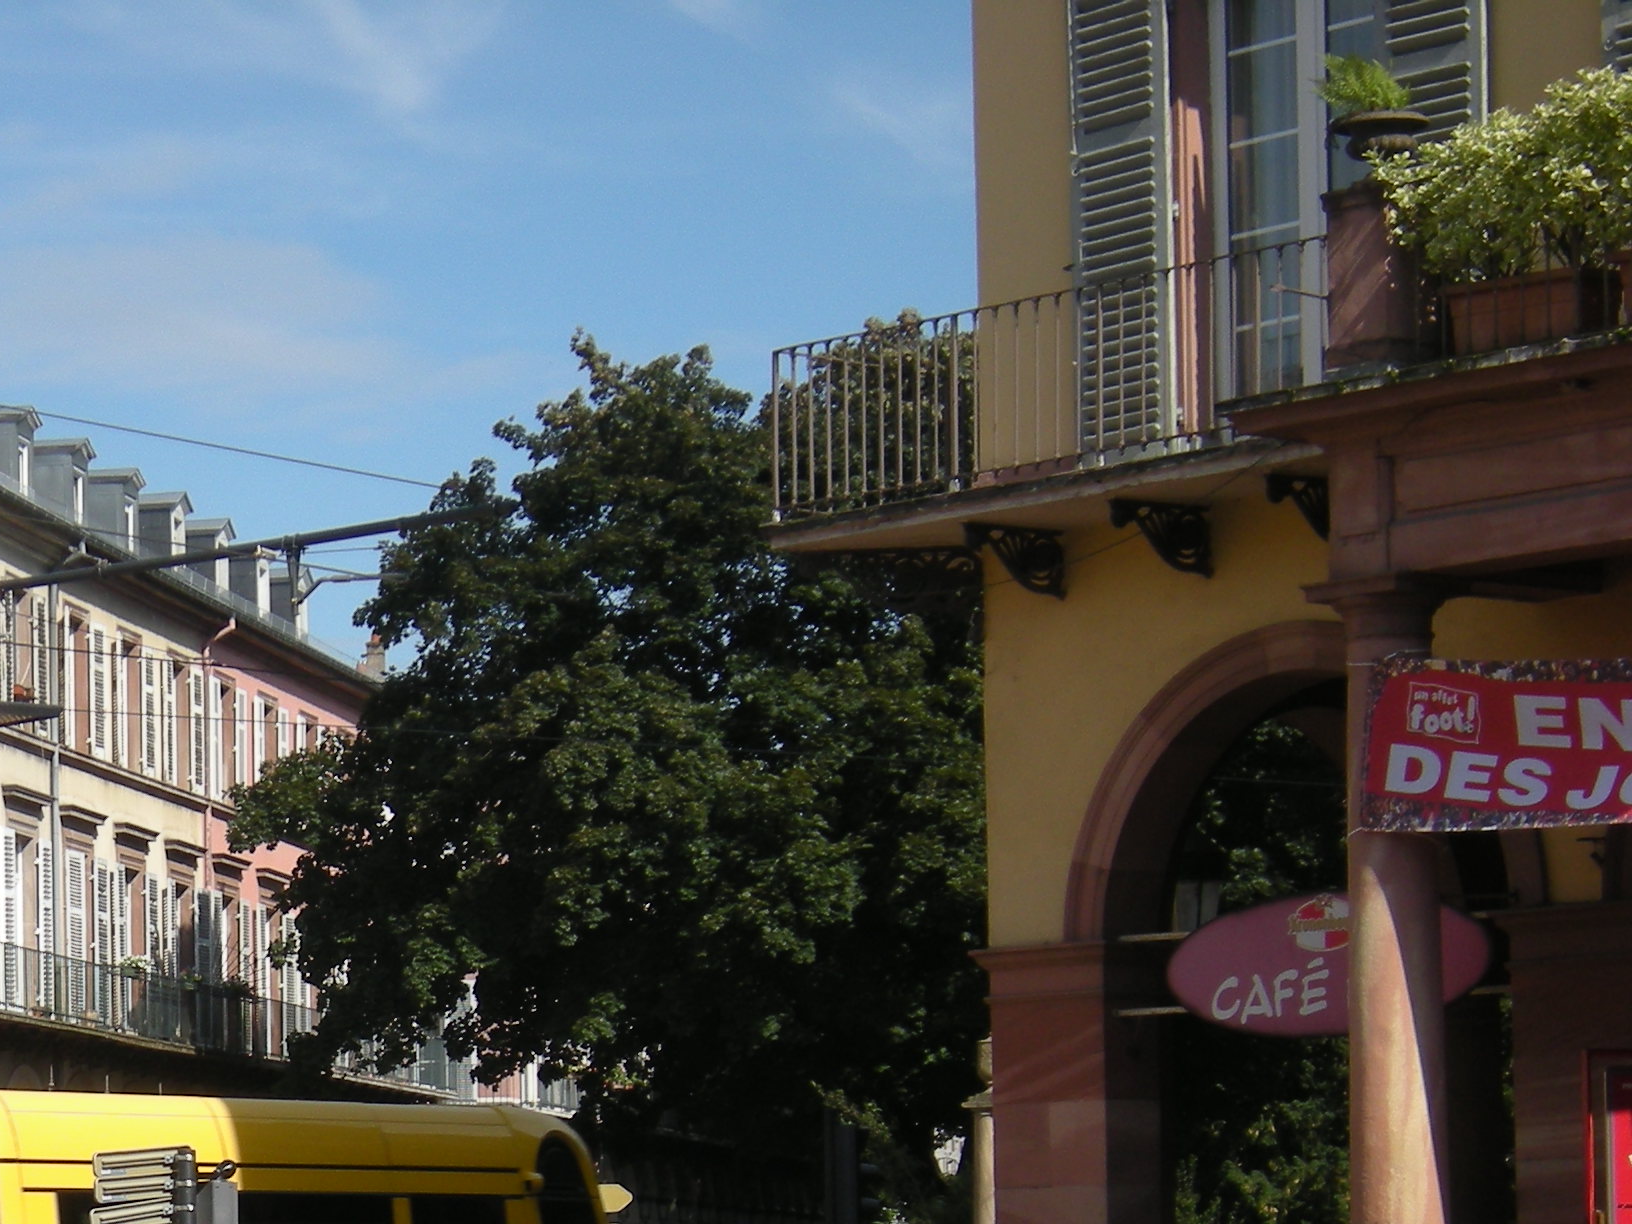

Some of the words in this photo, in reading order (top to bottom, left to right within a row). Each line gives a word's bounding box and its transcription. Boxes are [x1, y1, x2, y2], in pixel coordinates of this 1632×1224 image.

[1384, 743, 1552, 807] DES
[1565, 765, 1632, 810] J
[1211, 956, 1330, 1025] CAFÉ
